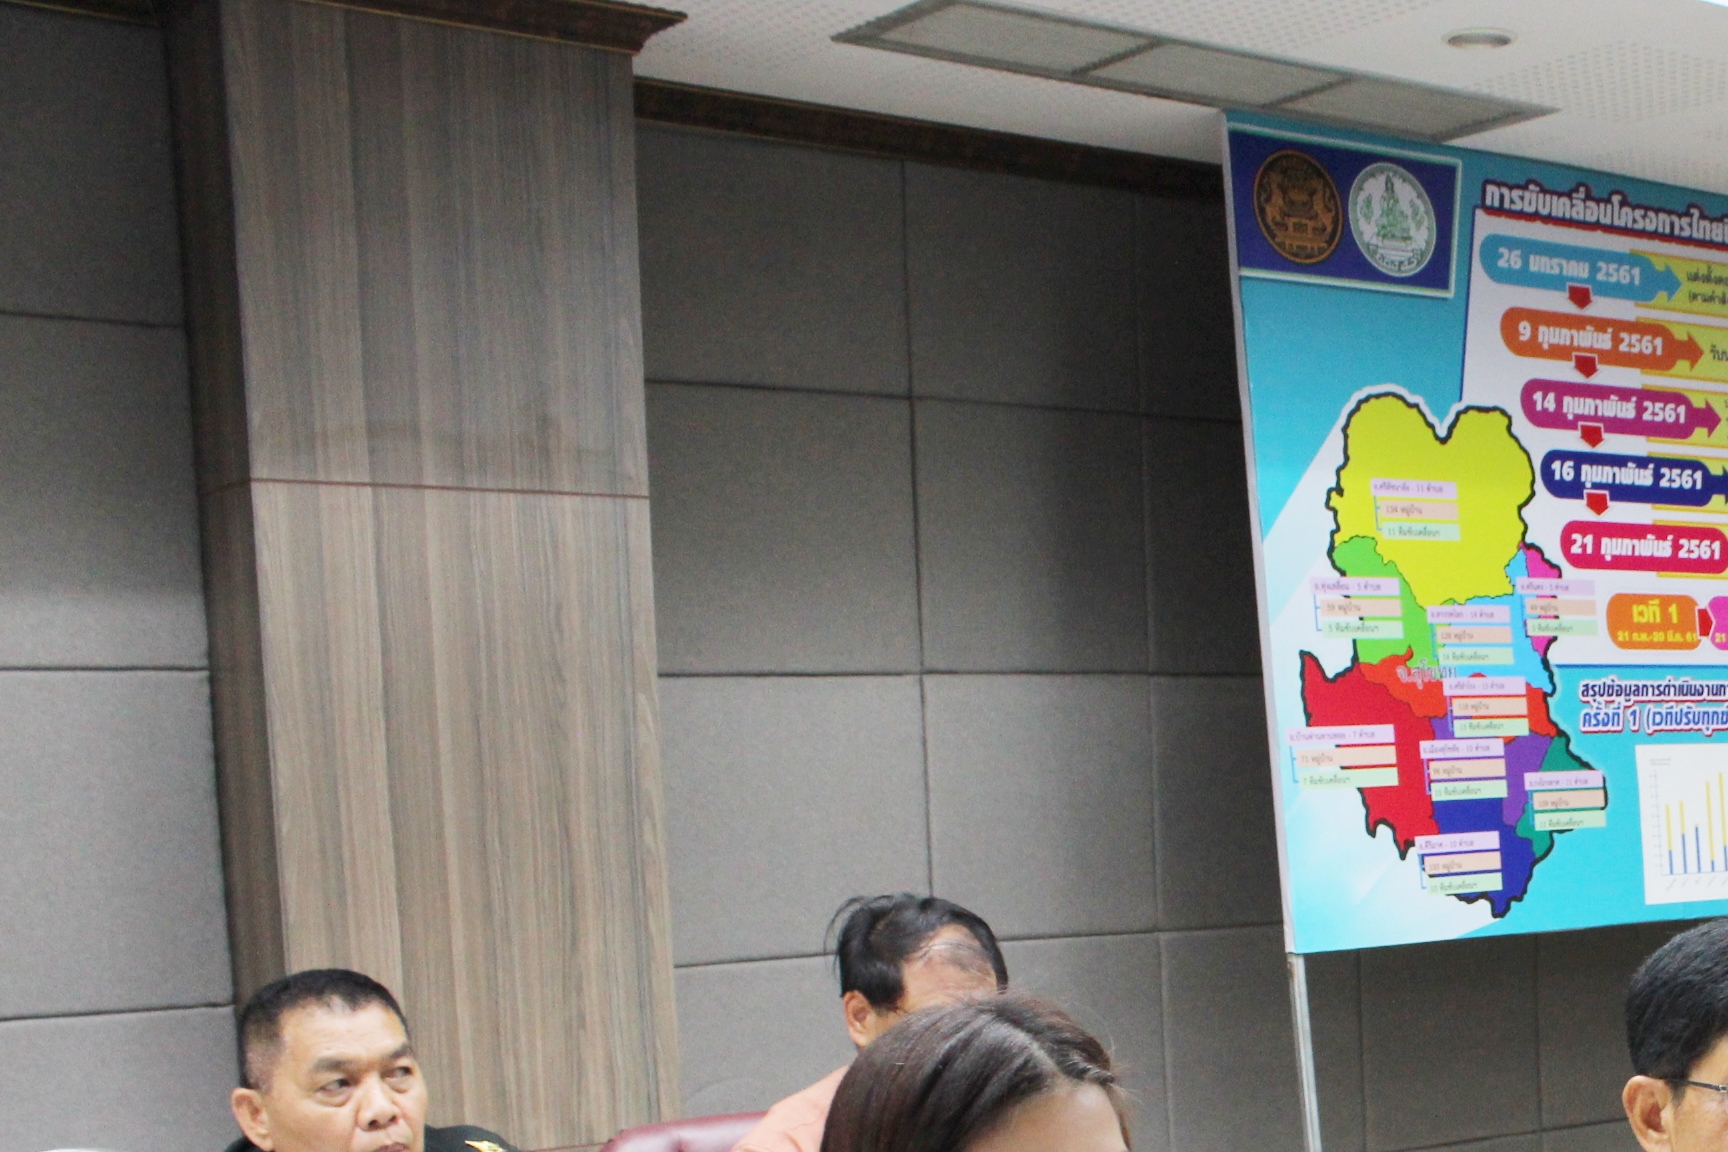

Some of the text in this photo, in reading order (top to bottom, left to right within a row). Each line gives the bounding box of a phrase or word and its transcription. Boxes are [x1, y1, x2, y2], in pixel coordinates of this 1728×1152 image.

[1497, 247, 1642, 286] 26 มกราคม 2561
[1518, 320, 1663, 355] 9 กุมภาพันธ์ 2561
[1532, 390, 1686, 424] 14 กุมภาพันธ์ 2561
[1551, 460, 1702, 490] 16 กุมภาพันธ์ 2561
[1570, 533, 1721, 561] 21 กุมภาพันธ์ 2561
[1632, 598, 1679, 624] เวที 1
[1582, 701, 1621, 728] ครั้งที่
[1628, 708, 1637, 727] 1
[1646, 705, 1728, 731] (เวทีปรับทุกข์
